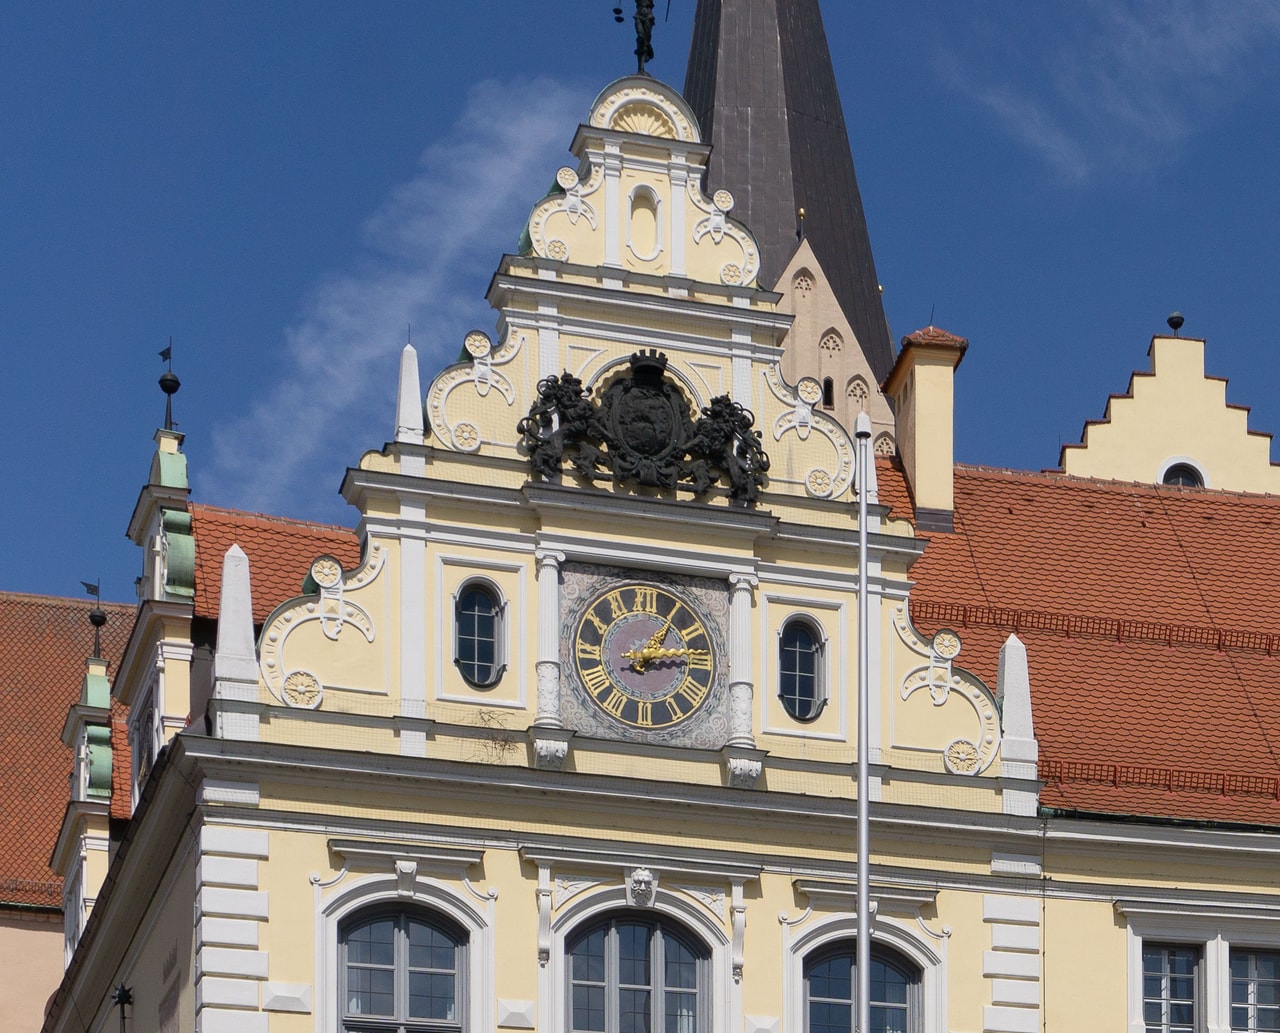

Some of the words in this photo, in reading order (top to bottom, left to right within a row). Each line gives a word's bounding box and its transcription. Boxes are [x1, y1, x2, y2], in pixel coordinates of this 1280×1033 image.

[607, 591, 627, 618] XI
[633, 588, 657, 613] XII
[586, 610, 608, 634] X
[681, 622, 704, 642] II
[577, 639, 600, 661] IX
[689, 654, 712, 671] III
[603, 688, 627, 717] VII
[637, 701, 652, 726] VI
[666, 698, 684, 721] V
